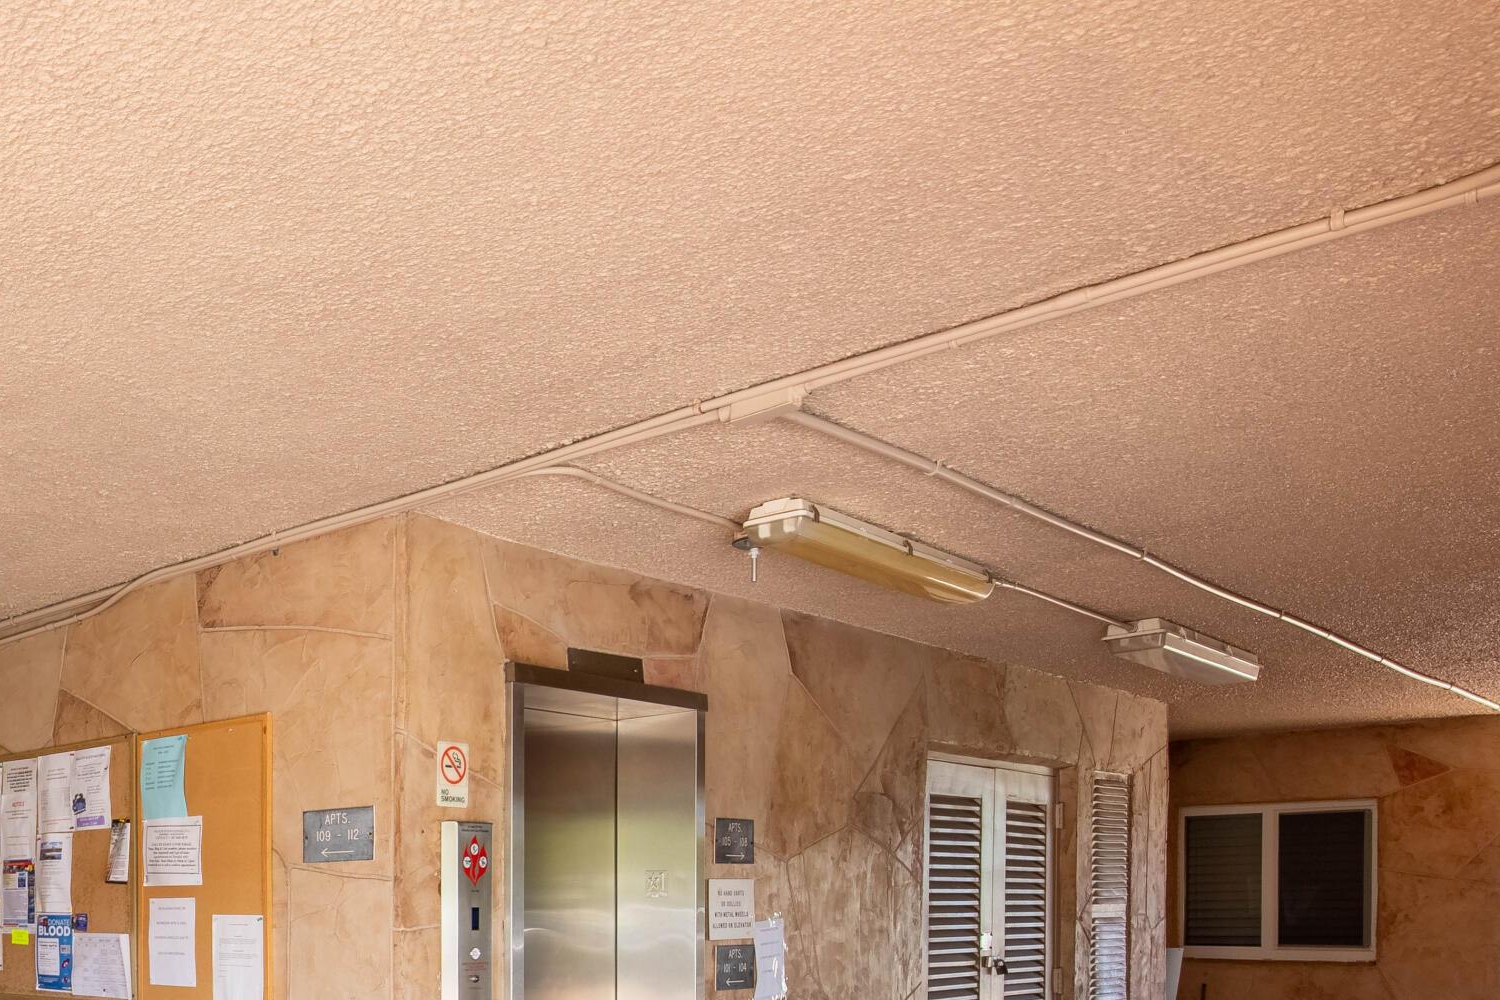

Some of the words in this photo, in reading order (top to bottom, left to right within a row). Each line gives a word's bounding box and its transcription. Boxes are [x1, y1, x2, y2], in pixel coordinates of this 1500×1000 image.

[324, 813, 351, 825] APTS.
[316, 831, 331, 842] 109
[347, 828, 359, 840] 112
[722, 836, 731, 847] 105
[739, 837, 748, 848] 108
[48, 918, 70, 926] DONATE
[38, 926, 71, 936] BLOOD
